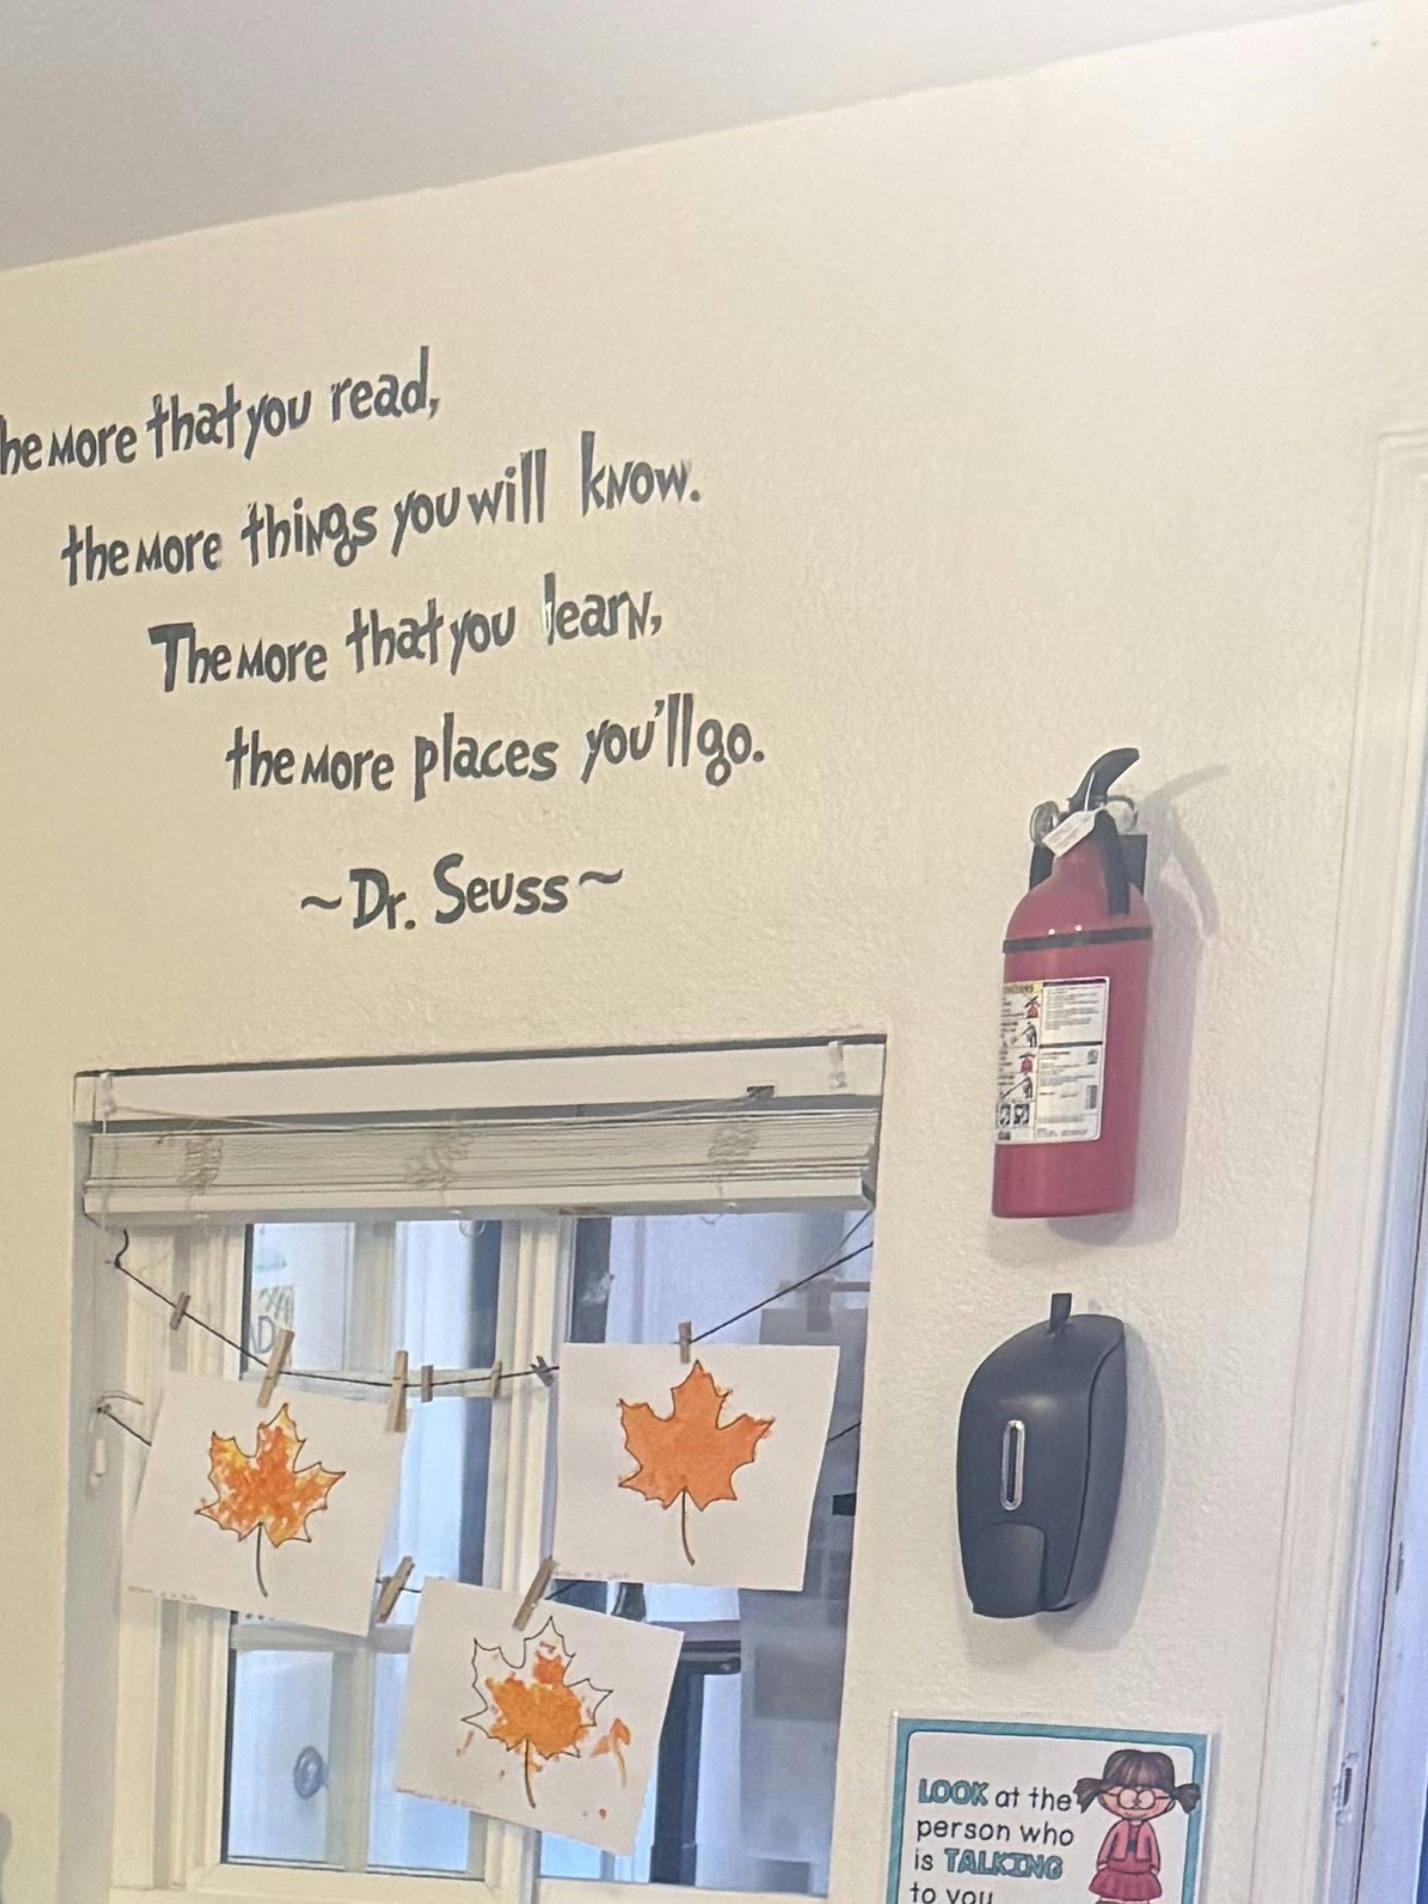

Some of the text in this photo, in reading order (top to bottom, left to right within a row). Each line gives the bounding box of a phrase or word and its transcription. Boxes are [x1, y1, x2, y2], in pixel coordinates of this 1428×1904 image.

[145, 385, 240, 457] that
[243, 388, 312, 459] you
[332, 346, 441, 420] read,
[61, 524, 130, 586] the
[392, 487, 461, 556] you
[466, 448, 546, 524] will
[148, 622, 231, 691] The
[345, 598, 443, 671] that
[449, 602, 516, 675] you
[226, 726, 296, 789] the
[413, 712, 558, 801] places
[581, 692, 695, 784] you'll
[702, 717, 765, 786] go.
[917, 1779, 1072, 1812] LOOK at the
[916, 1818, 1075, 1846] person who
[910, 1883, 936, 1904] to
[915, 1848, 1063, 1880] is TALKING
